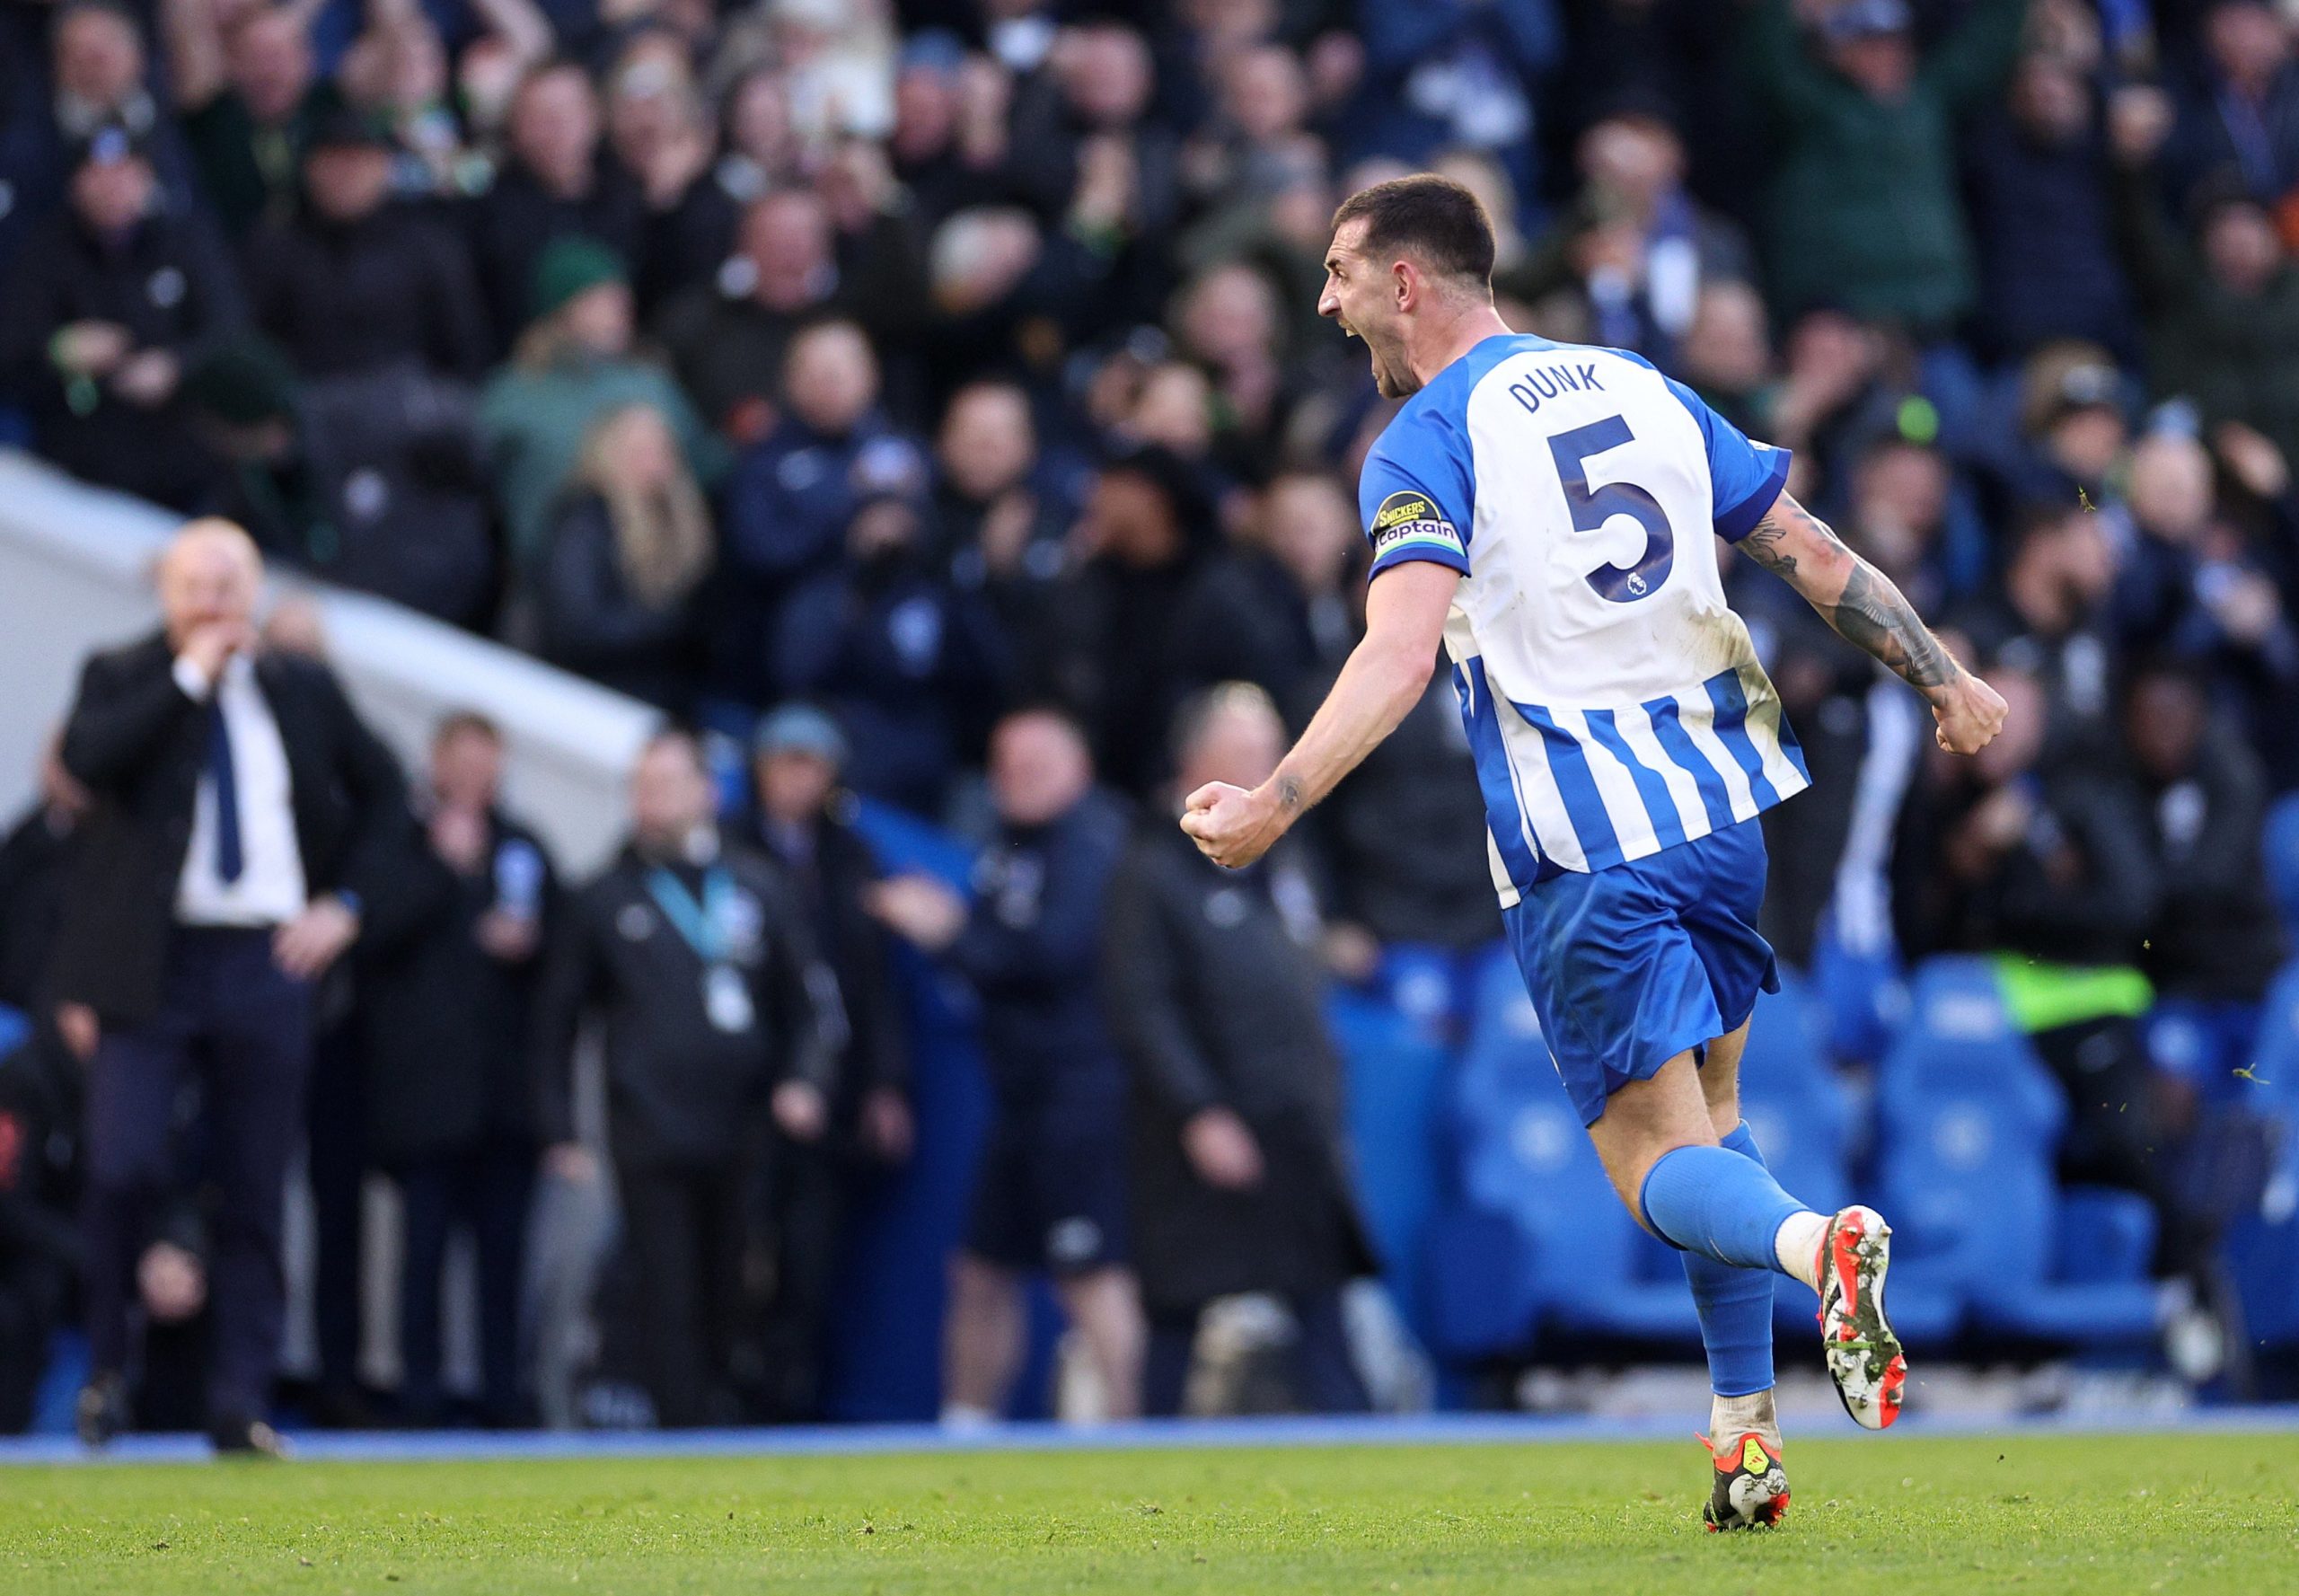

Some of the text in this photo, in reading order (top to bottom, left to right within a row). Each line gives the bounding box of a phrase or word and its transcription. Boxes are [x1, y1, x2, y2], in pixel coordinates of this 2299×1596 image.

[1509, 364, 1606, 413] DUNK
[1379, 501, 1426, 527] SNICKERS
[1547, 414, 1674, 603] 5
[1379, 520, 1455, 546] captain
